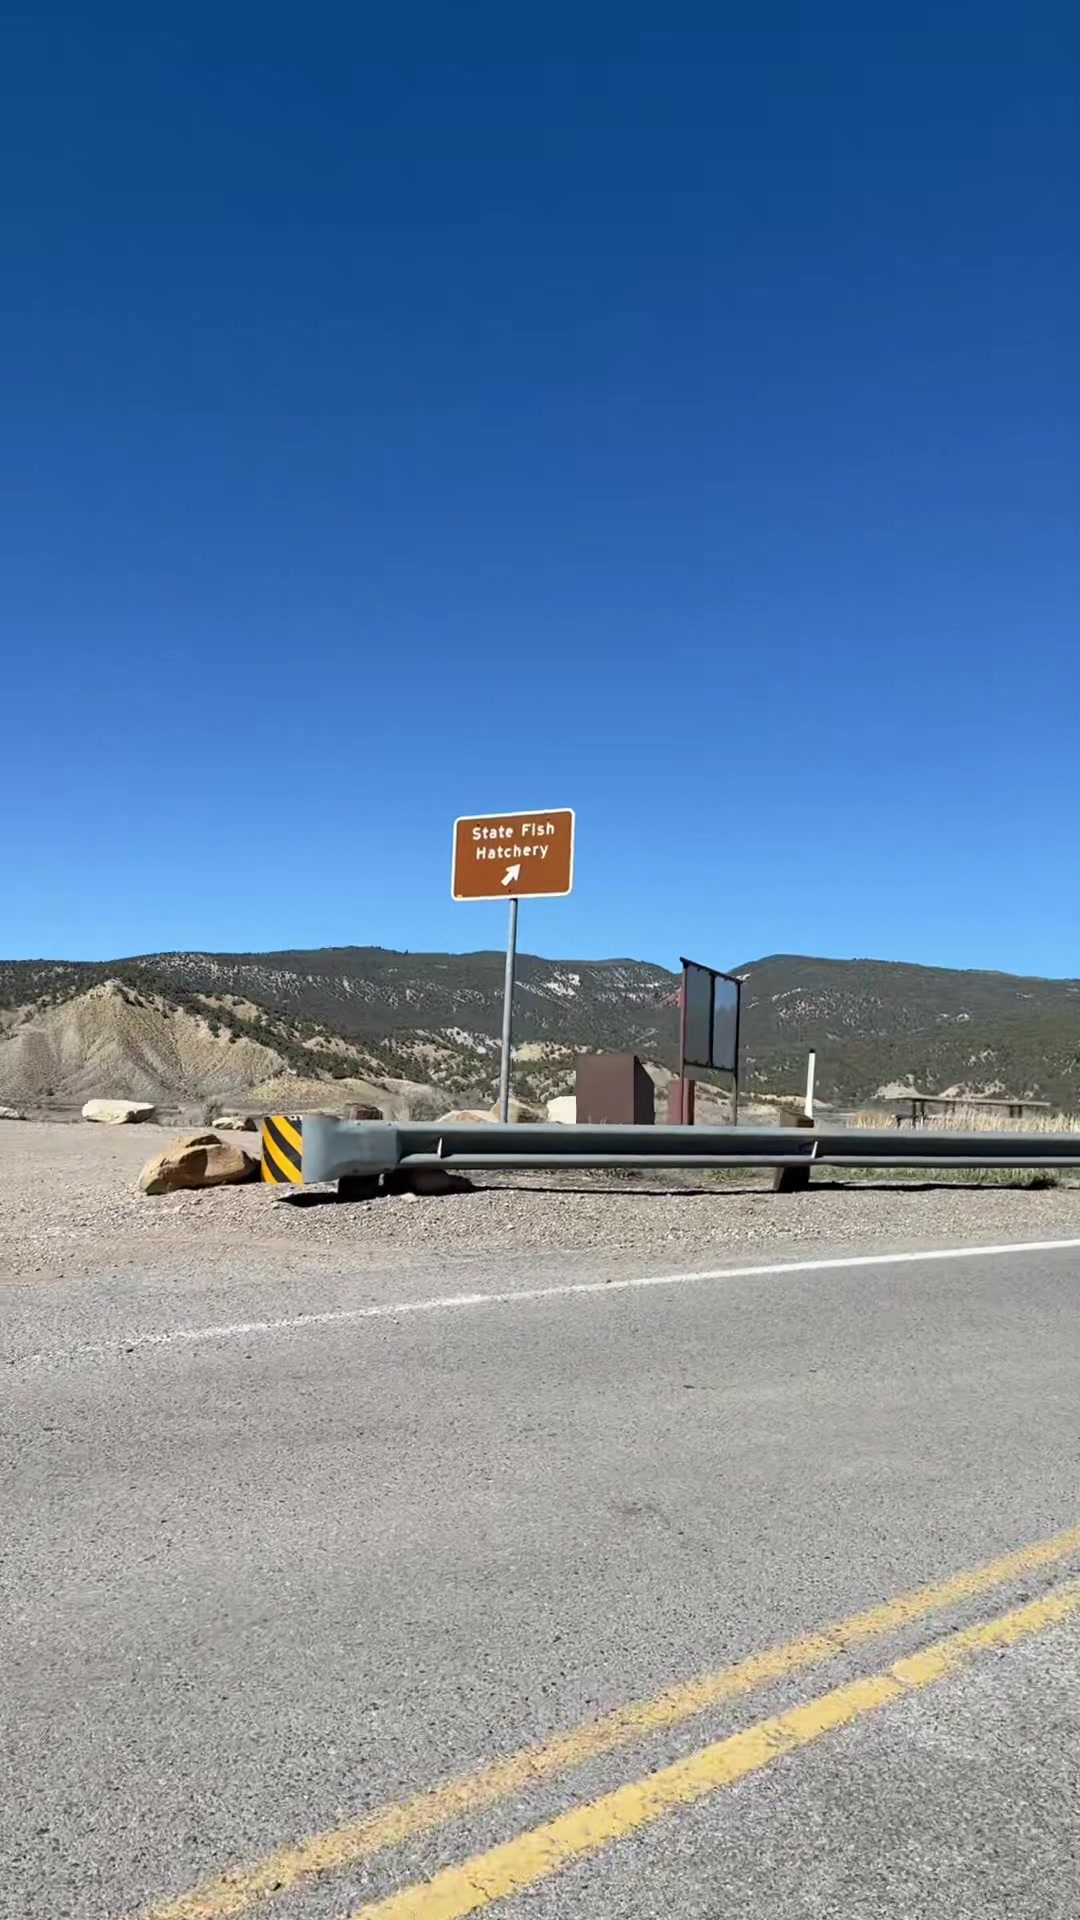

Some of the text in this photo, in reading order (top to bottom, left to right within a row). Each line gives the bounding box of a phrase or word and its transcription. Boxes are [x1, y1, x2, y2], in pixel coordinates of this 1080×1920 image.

[472, 822, 555, 841] State Fish
[476, 844, 549, 860] Hatchery
